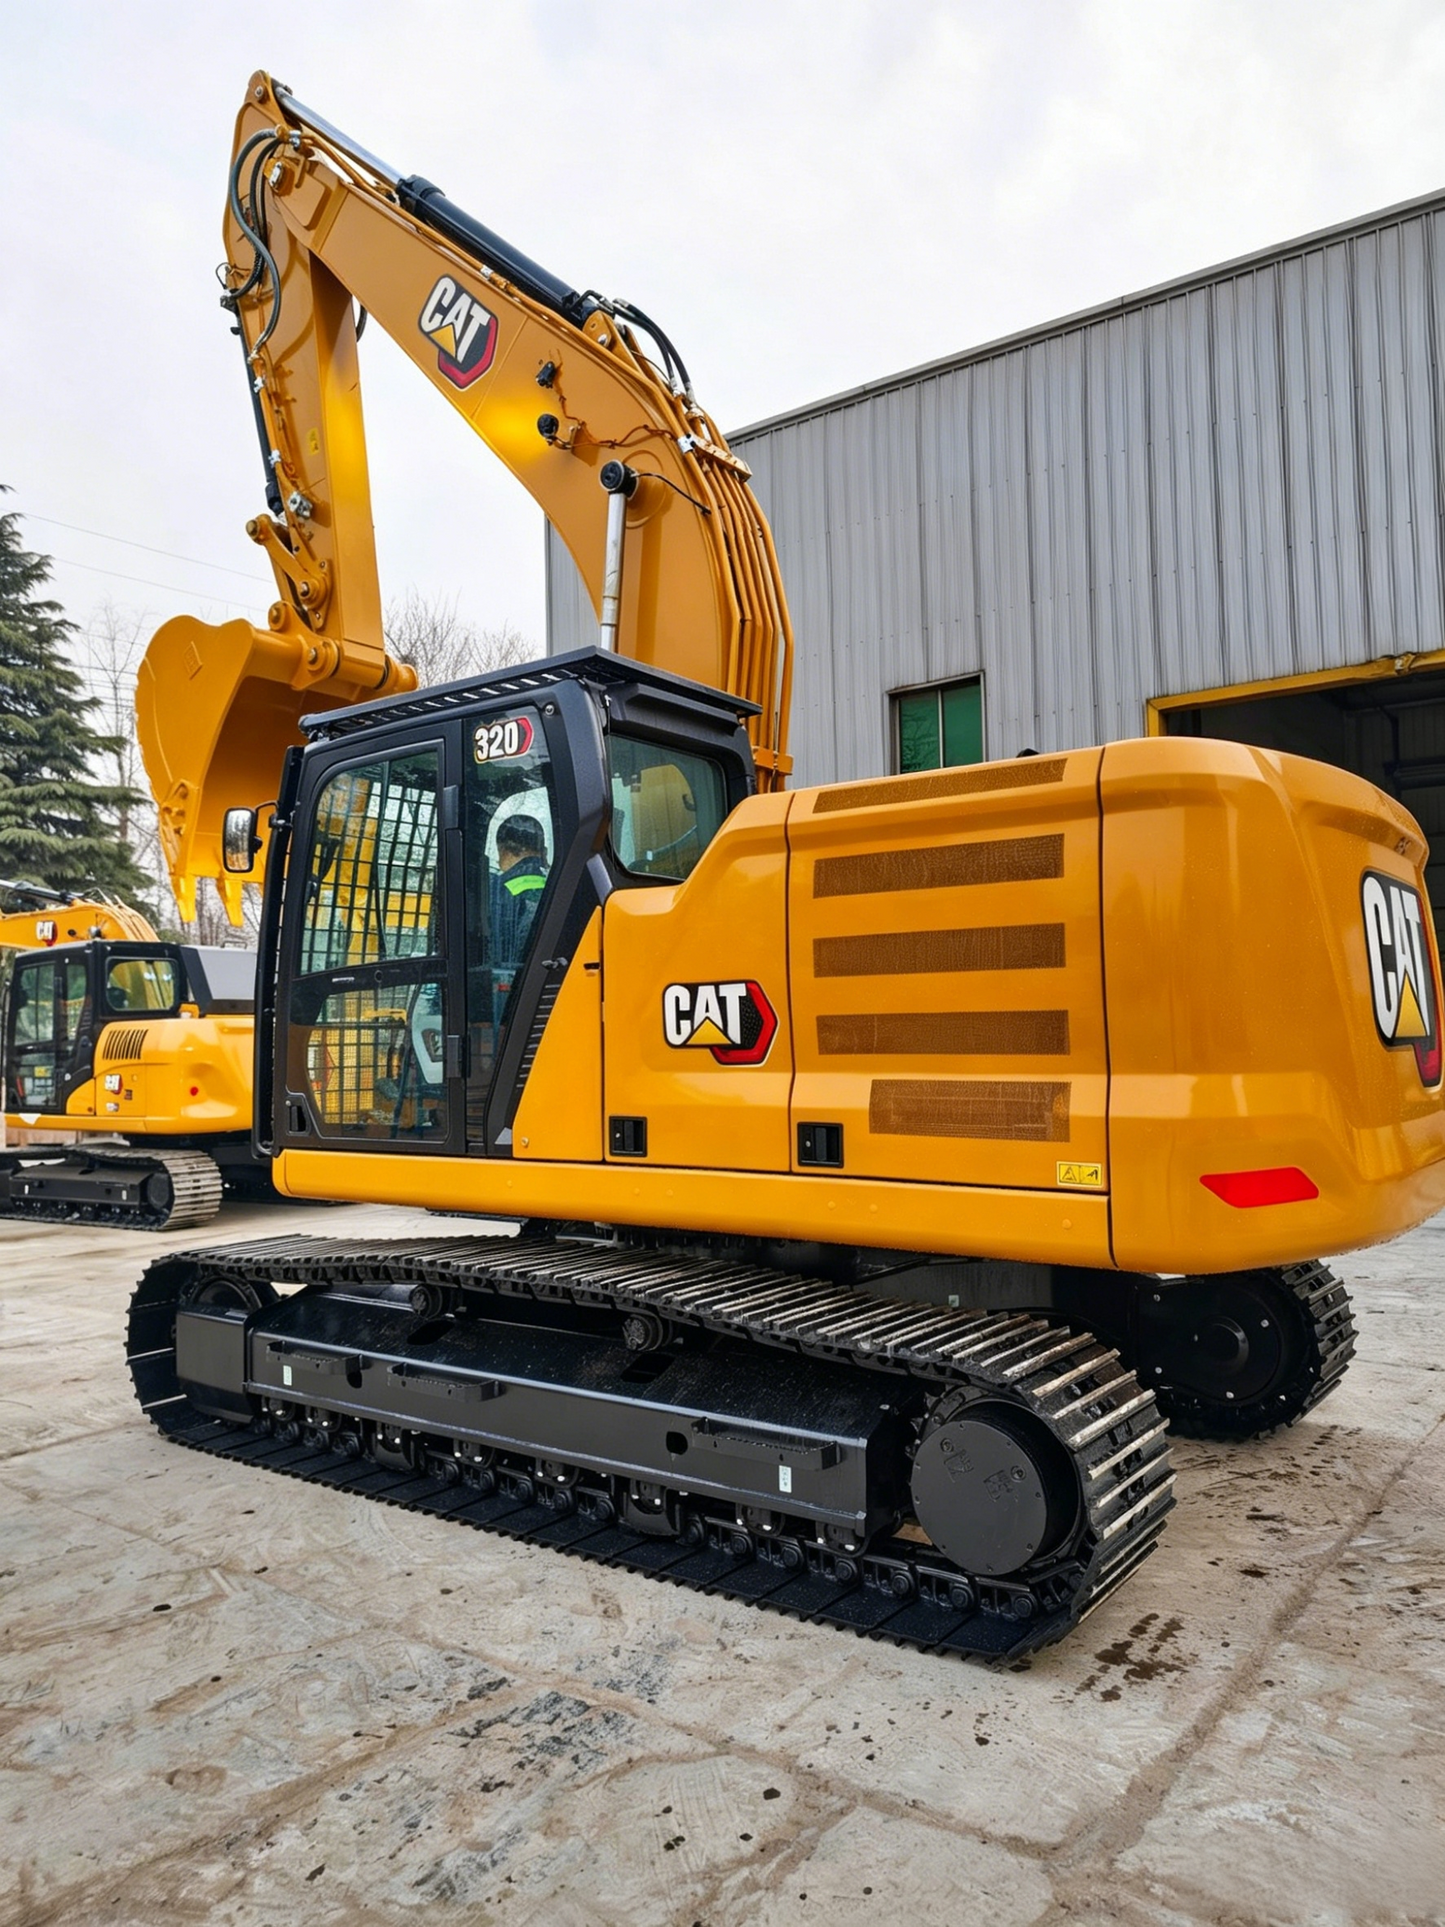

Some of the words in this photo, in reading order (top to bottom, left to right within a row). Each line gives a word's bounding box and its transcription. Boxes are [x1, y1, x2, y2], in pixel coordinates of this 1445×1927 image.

[421, 276, 491, 364] CAT
[475, 721, 519, 760] 320
[1363, 876, 1430, 1038] CAT
[664, 982, 747, 1046] CAT
